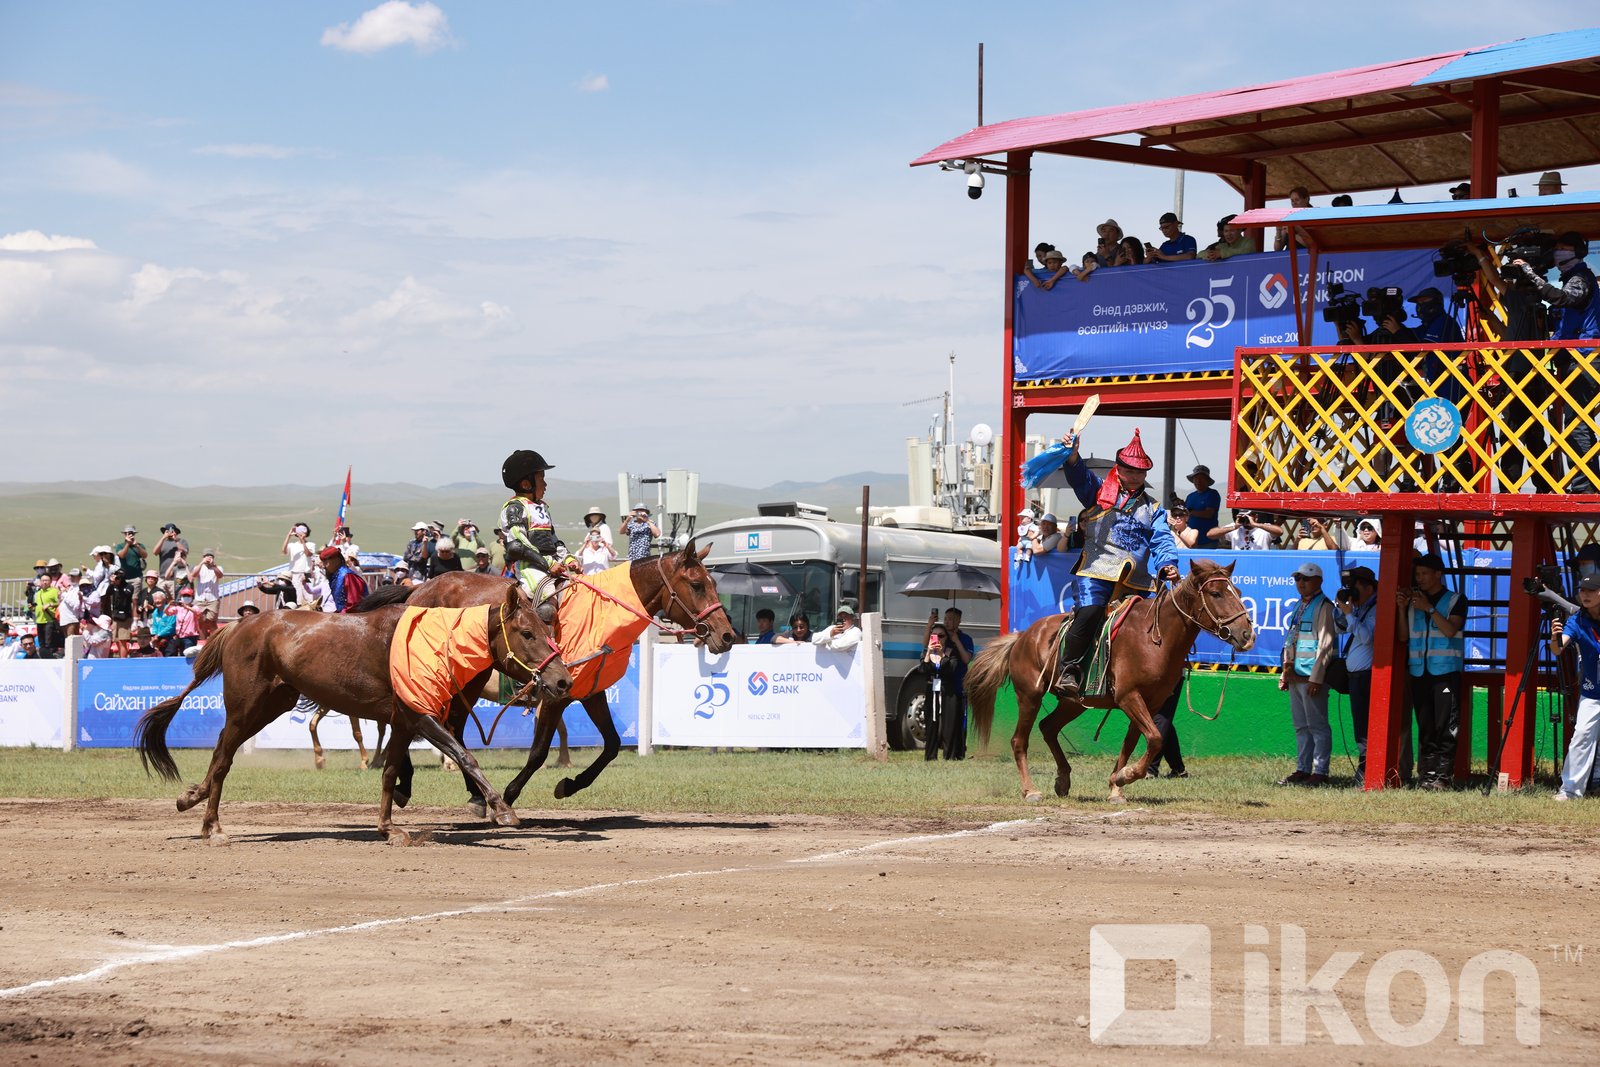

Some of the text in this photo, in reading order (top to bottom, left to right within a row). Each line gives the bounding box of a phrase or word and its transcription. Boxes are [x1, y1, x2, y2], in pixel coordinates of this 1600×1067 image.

[1093, 302, 1168, 316] Өнөд дэвжих,
[1186, 275, 1235, 349] 25
[1078, 320, 1168, 335] өсөлтийн түүчээ
[1259, 333, 1283, 345] since
[772, 673, 823, 682] CAPITRON
[694, 671, 730, 720] 25
[772, 685, 799, 694] BANK
[94, 692, 146, 711] Сайхан
